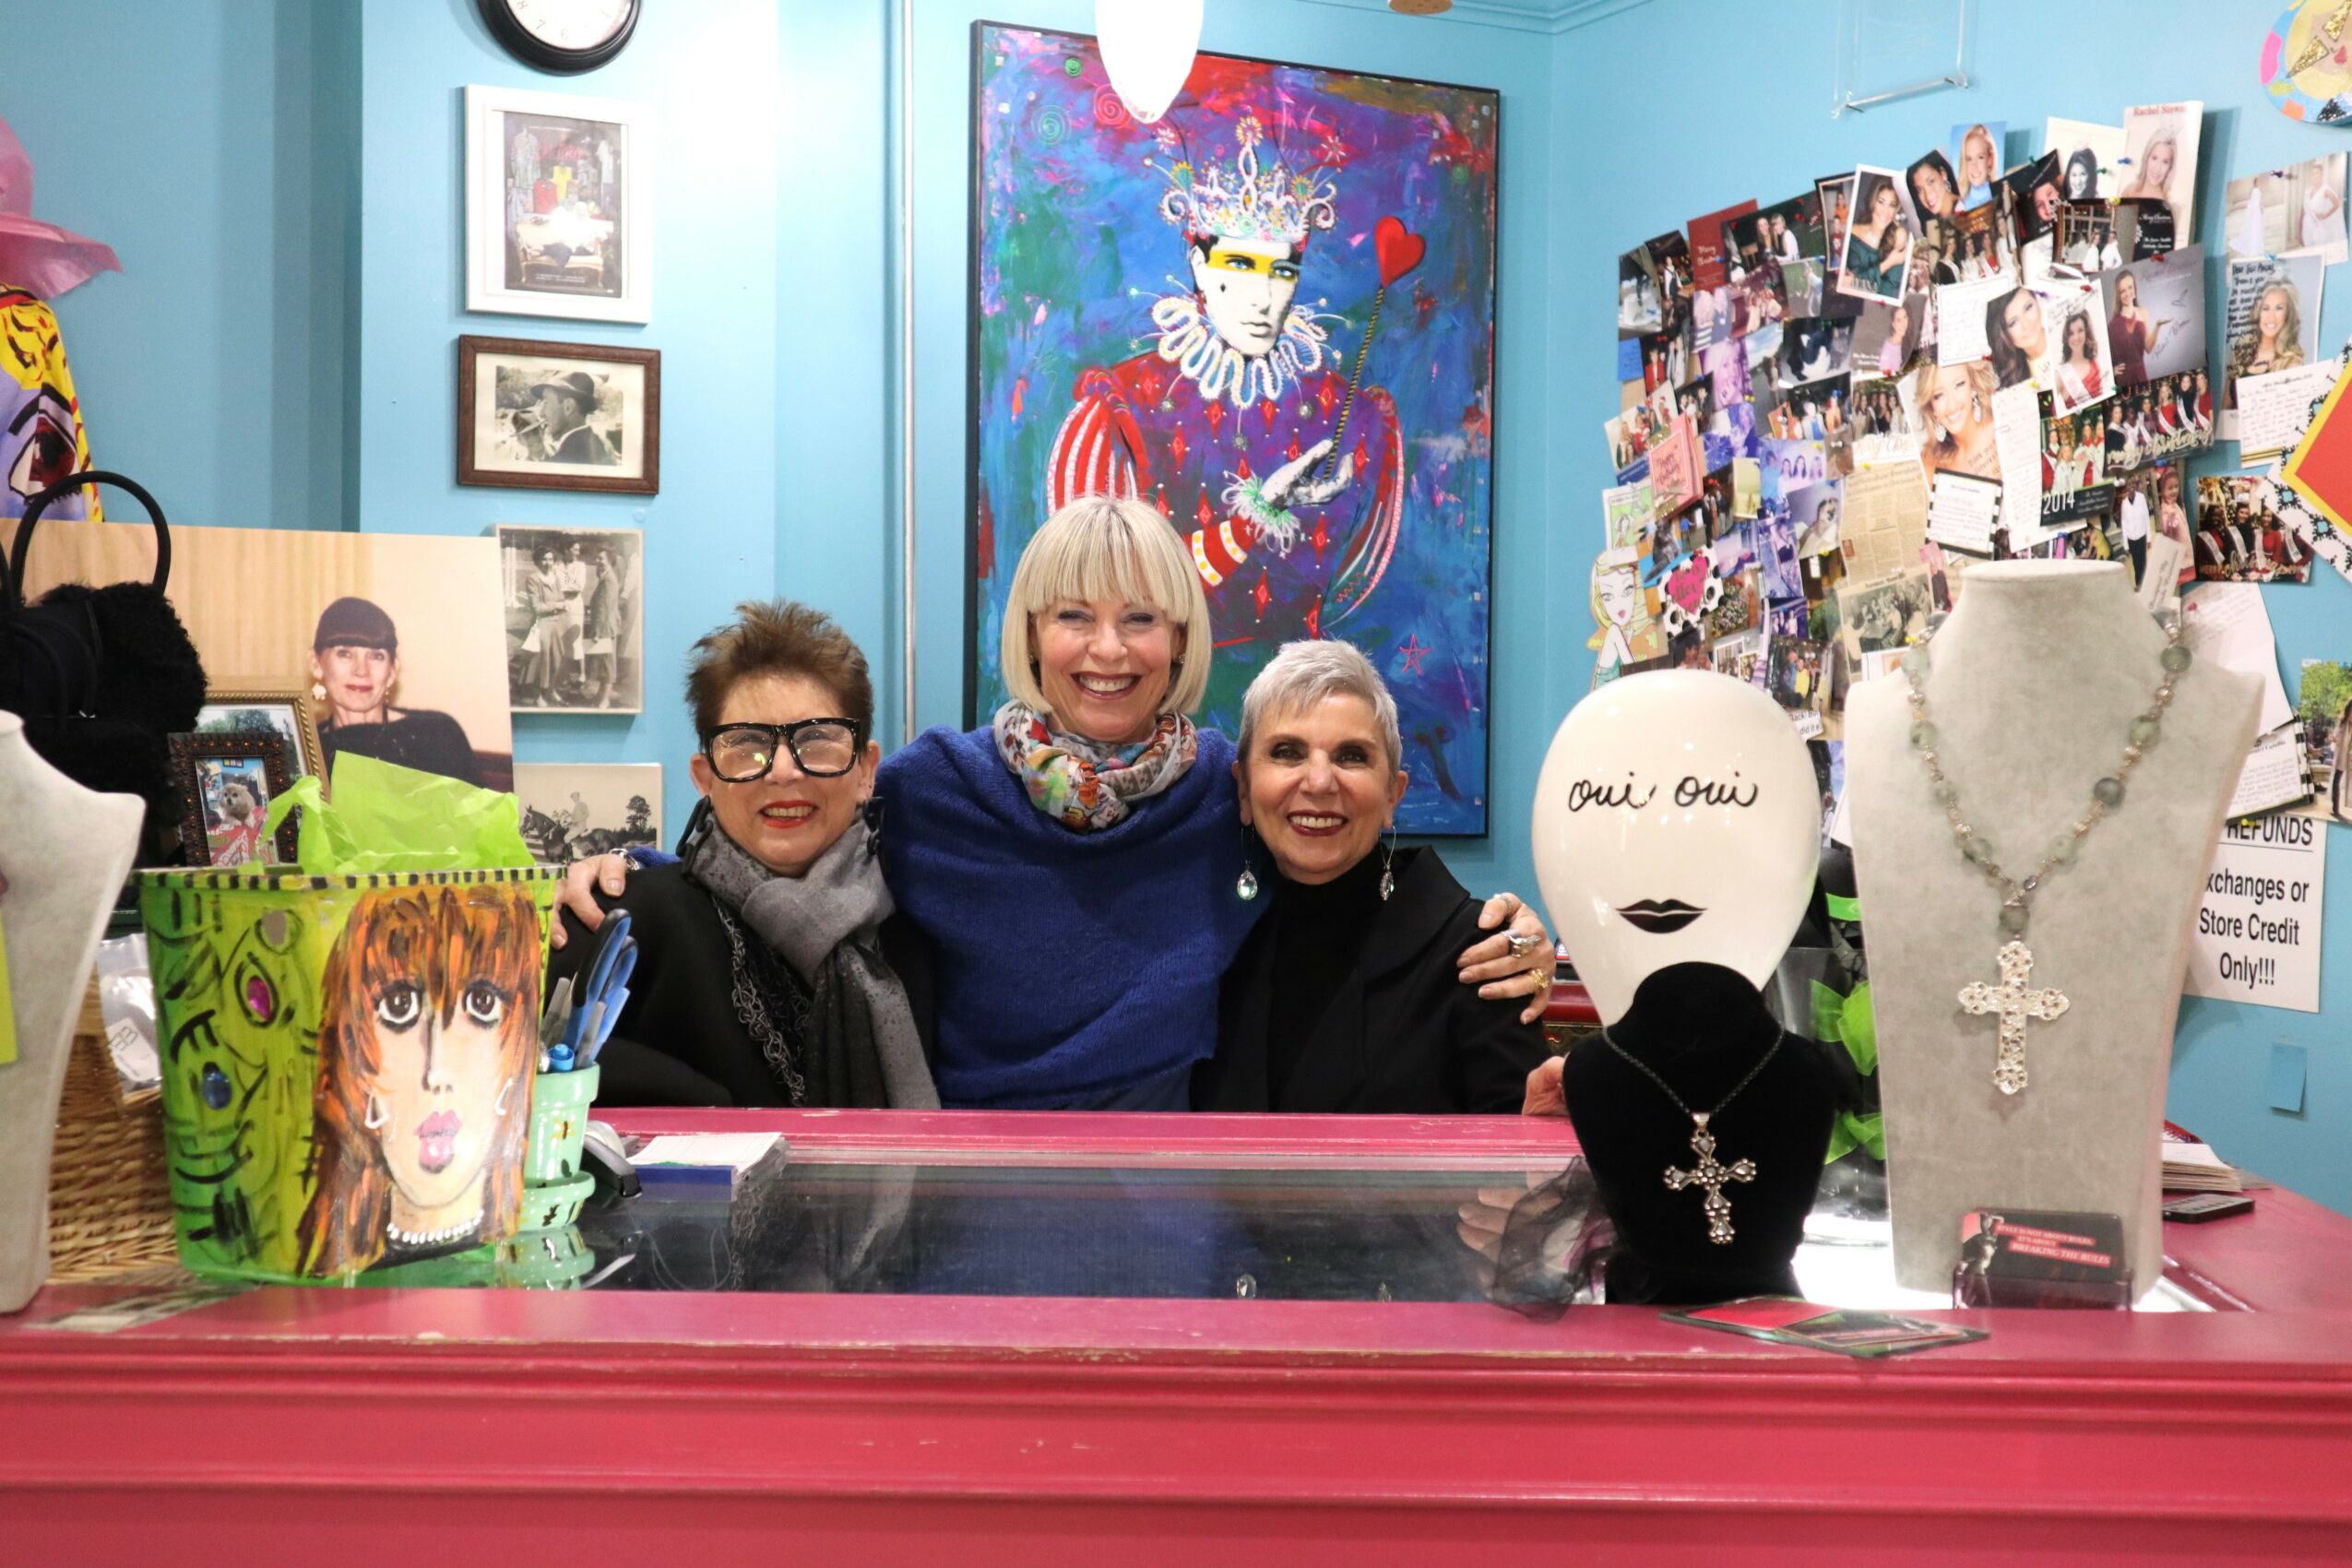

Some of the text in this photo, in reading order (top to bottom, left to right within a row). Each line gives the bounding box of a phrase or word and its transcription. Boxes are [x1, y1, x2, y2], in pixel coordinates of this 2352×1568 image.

[2042, 487, 2075, 515] 2014
[1569, 771, 1657, 813] oui
[2206, 868, 2310, 905] xchanges or
[2199, 908, 2300, 946] Store Credit
[2219, 952, 2275, 990] Only!!!
[2028, 1229, 2042, 1237] NOT
[2043, 1231, 2067, 1241] ABOUT
[2033, 1239, 2057, 1247] ABOUT
[2012, 1242, 2059, 1255] BREAKING
[2061, 1250, 2080, 1261] THE
